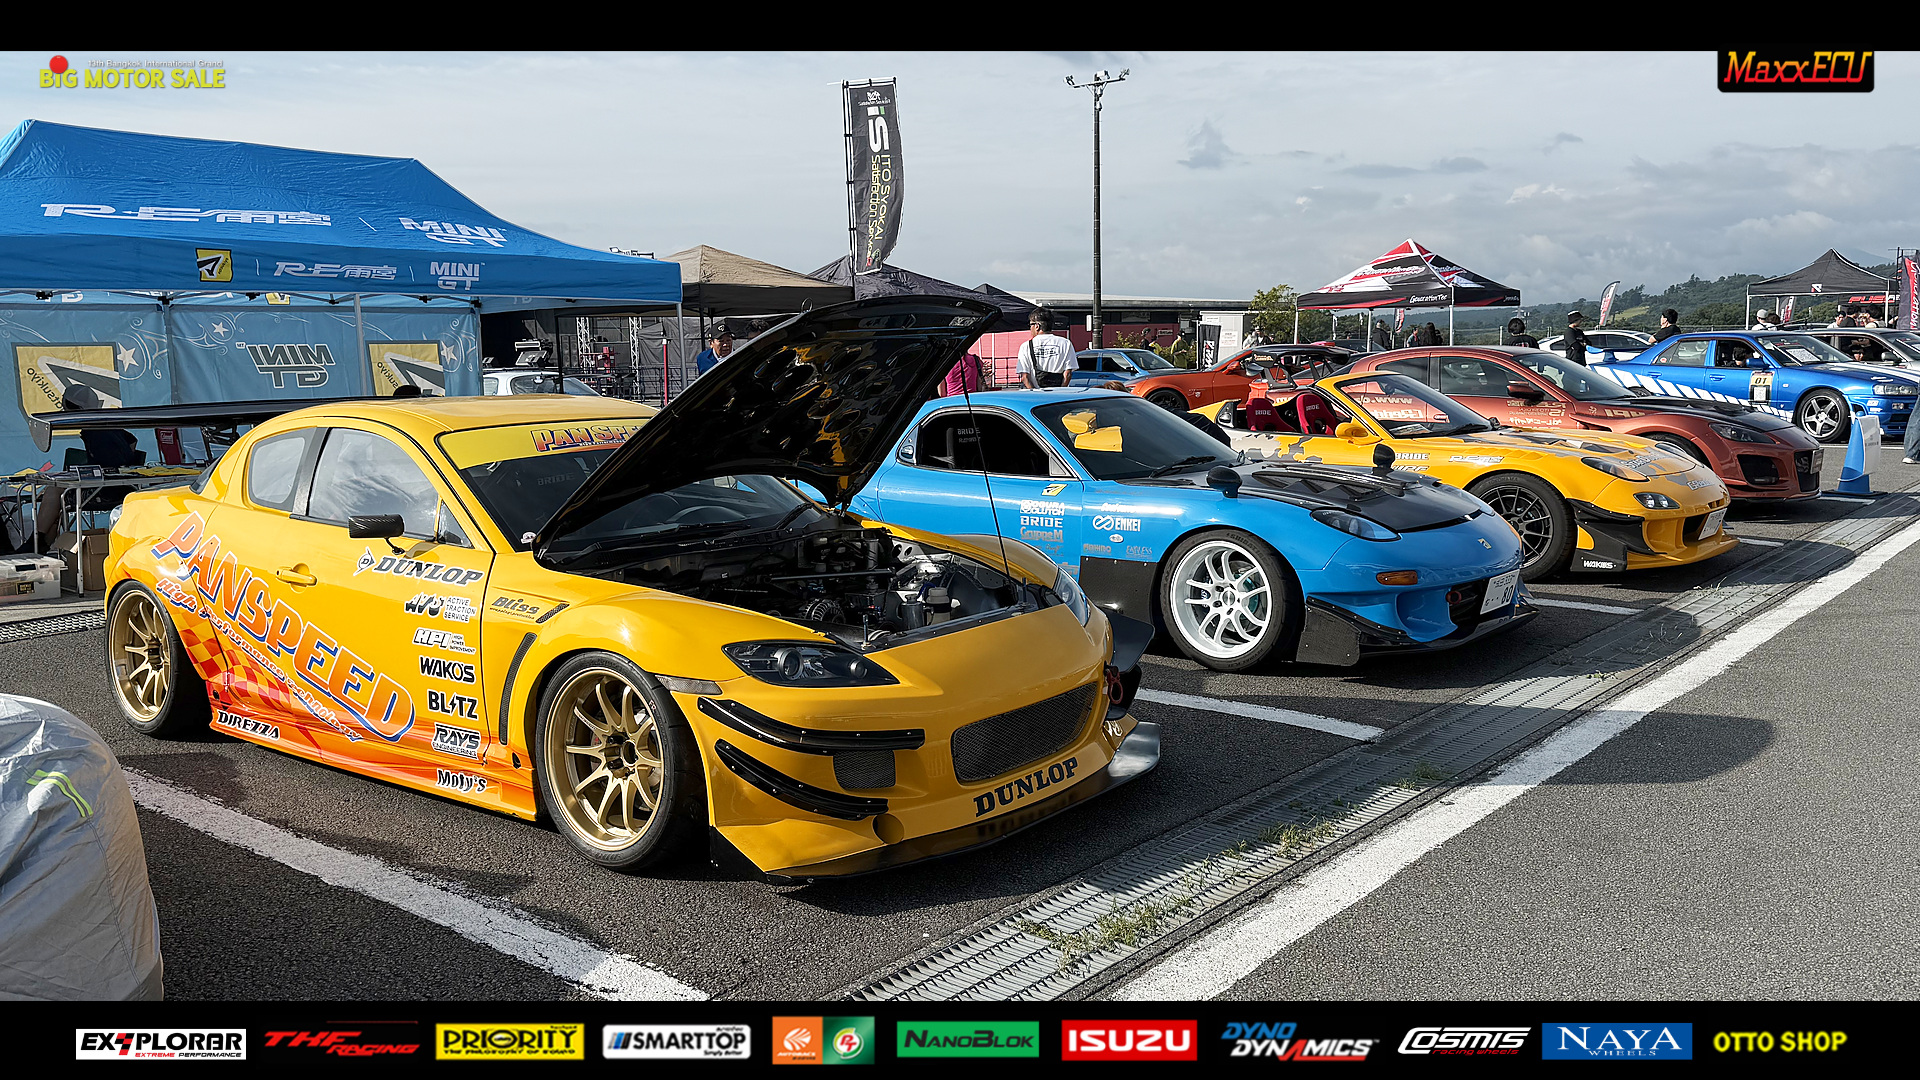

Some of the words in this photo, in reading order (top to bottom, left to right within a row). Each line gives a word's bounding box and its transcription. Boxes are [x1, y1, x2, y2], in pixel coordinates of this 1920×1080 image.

[881, 154, 891, 182] ITO
[870, 155, 881, 218] Satisfaction
[398, 217, 504, 238] MINI
[430, 261, 480, 276] MINI
[437, 276, 479, 291] GT
[537, 472, 575, 486] BRIDE
[1020, 516, 1063, 528] BRIDE
[1115, 518, 1141, 531] ENKEI
[373, 556, 484, 586] DUNLOP
[445, 604, 477, 615] TRACTION
[447, 597, 470, 606] ACTIVE
[491, 596, 540, 615] Bliss
[151, 510, 416, 742] PANSPEED
[444, 611, 470, 622] SERVICE
[156, 578, 197, 613] High
[198, 603, 286, 683] Performance
[413, 629, 452, 649] HPI
[428, 690, 478, 720] BLITZ
[216, 710, 281, 740] DIREZZA
[434, 727, 480, 750] RAYS
[436, 769, 487, 792] Moty's
[973, 756, 1078, 818] DUNLOP
